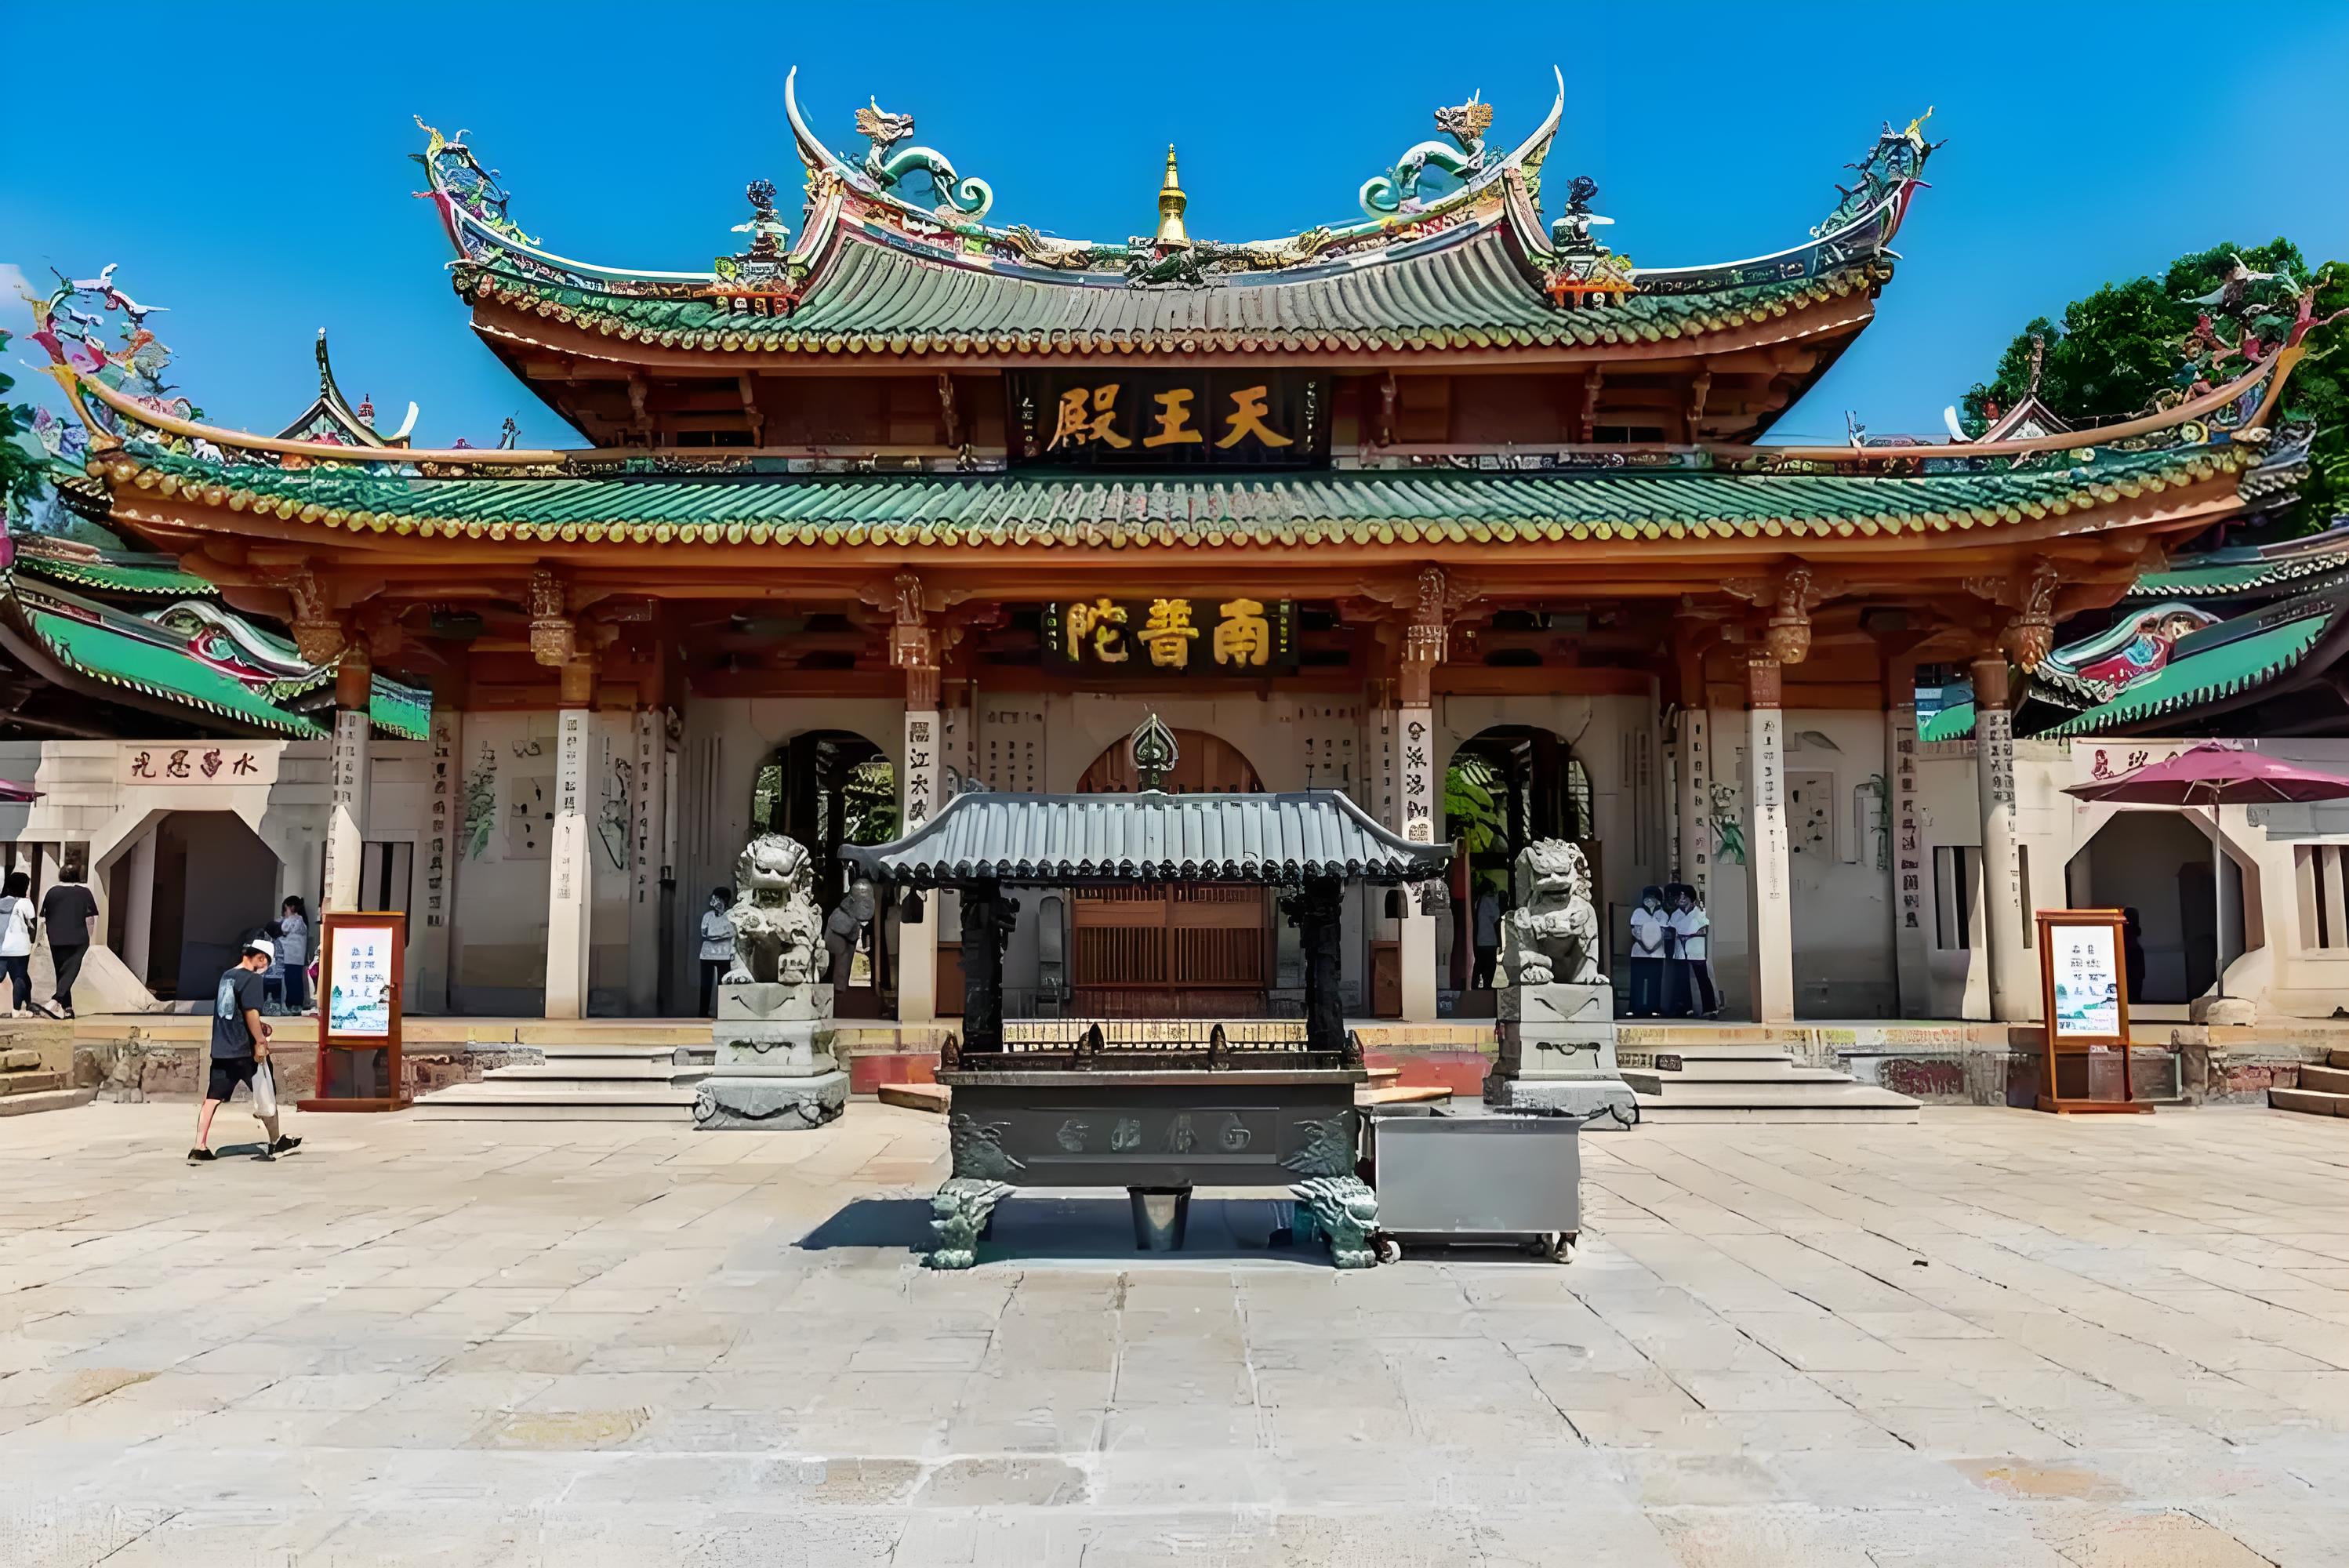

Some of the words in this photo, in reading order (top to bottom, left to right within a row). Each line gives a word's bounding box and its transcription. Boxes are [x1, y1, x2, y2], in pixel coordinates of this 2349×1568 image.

[1047, 383, 1294, 452] 天王殿
[1066, 598, 1269, 668] 南普陀
